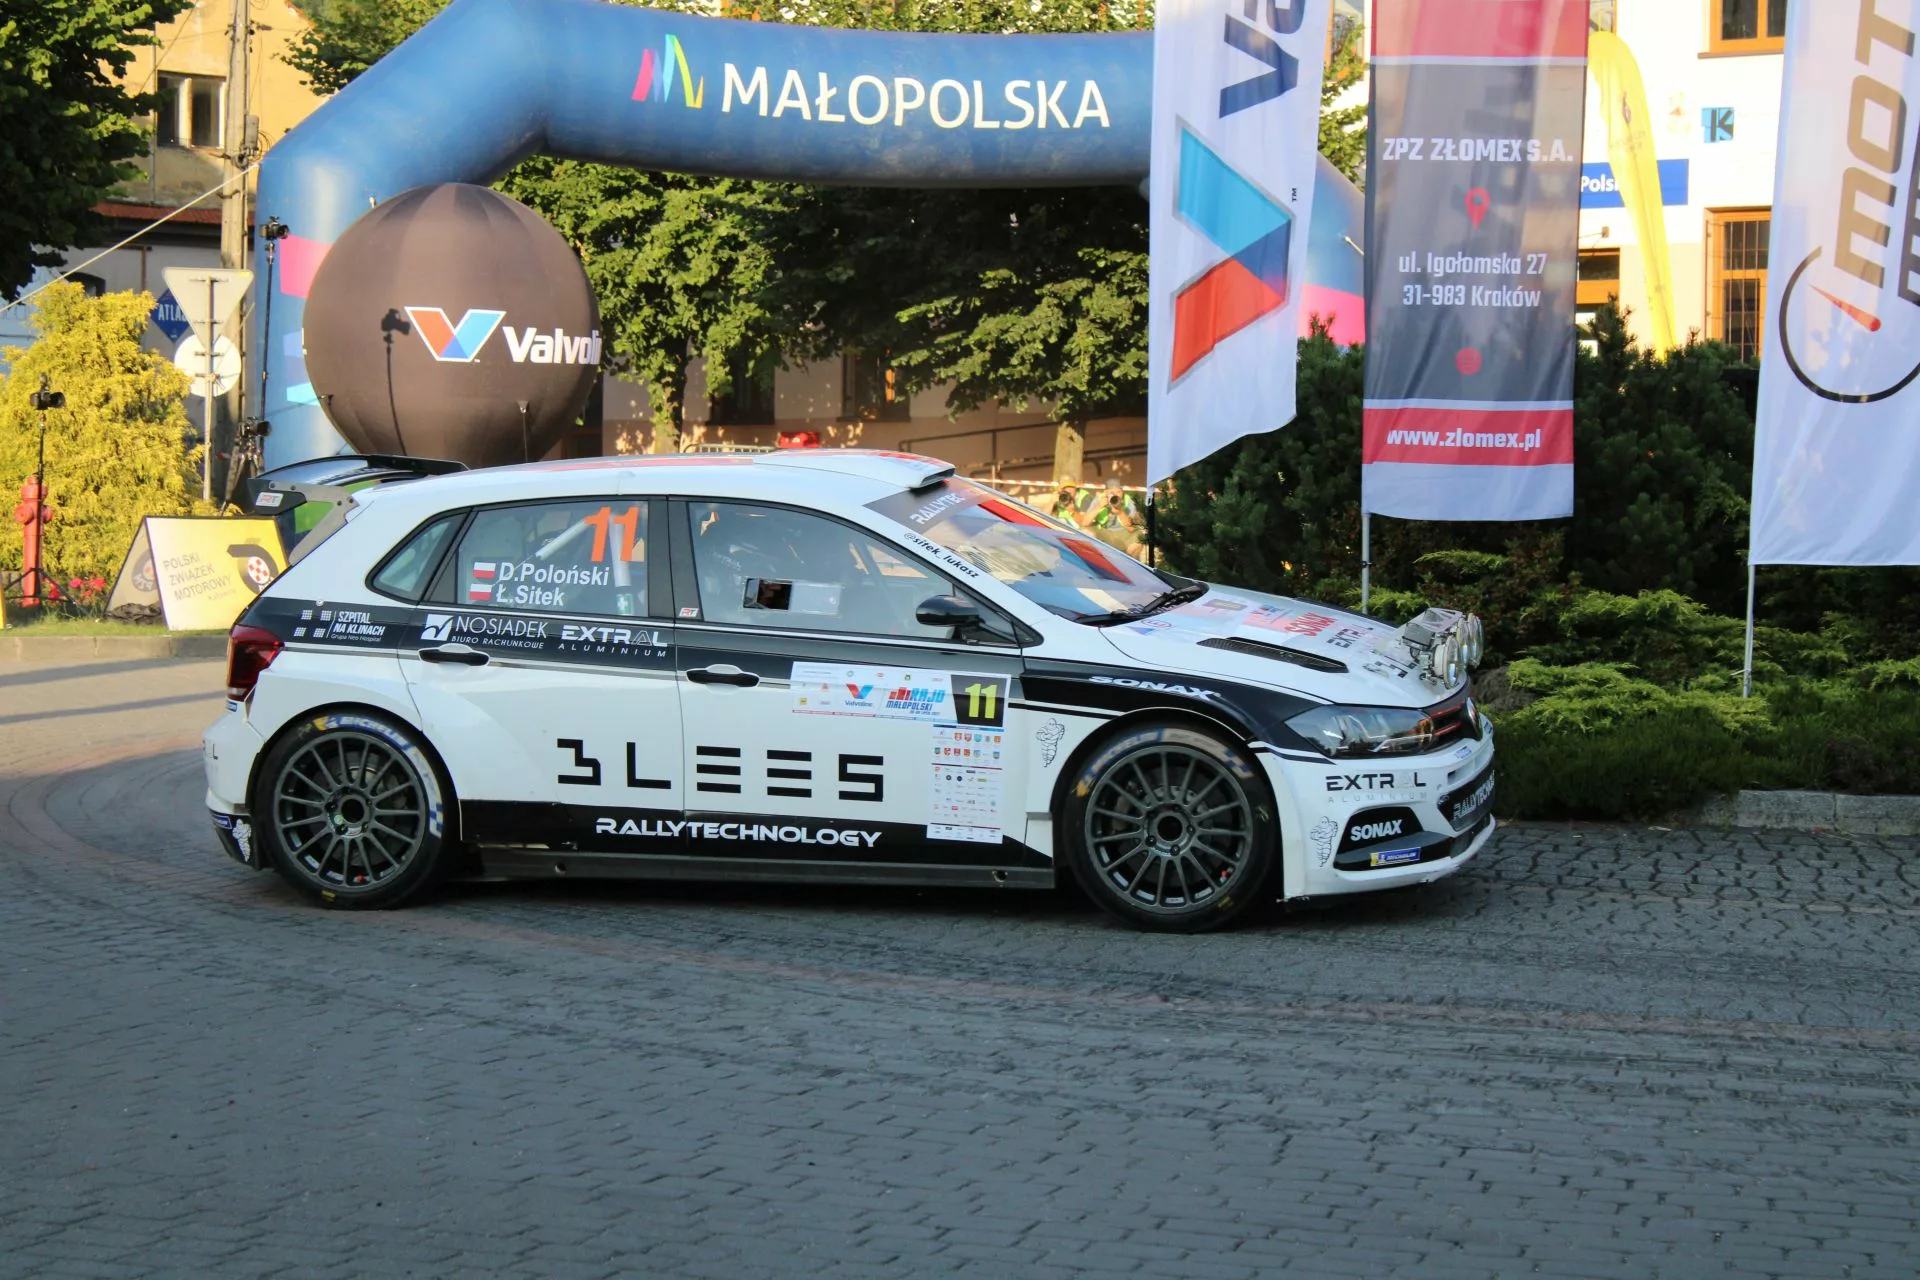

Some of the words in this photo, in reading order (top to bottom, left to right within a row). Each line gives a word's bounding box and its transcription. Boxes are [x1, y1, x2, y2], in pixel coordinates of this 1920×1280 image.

[721, 62, 1110, 129] MAŁOPOLSKA
[1383, 138, 1424, 161] ZPZ
[1430, 138, 1522, 162] ZŁOMEX
[1526, 138, 1574, 162] S.A.
[1398, 253, 1421, 274] ul.
[1427, 252, 1521, 275] Igołomska
[1526, 253, 1547, 274] 27
[1402, 285, 1466, 306] 31-983
[1471, 286, 1541, 307] Kraków
[1387, 428, 1541, 449] www.zlomex.pl
[584, 505, 640, 562] 11
[163, 552, 200, 570] POLSKI
[499, 562, 610, 586] D.Poloński
[496, 584, 564, 606] Ł.Sitek
[337, 611, 371, 624] SZPITAL
[455, 616, 548, 639] NOSIADEK
[333, 623, 346, 634] NA
[346, 625, 386, 637] KLINACH
[561, 625, 668, 648] EXTRAL
[451, 635, 479, 644] BIURO
[482, 638, 544, 649] RACHUNKOWE
[558, 643, 666, 657] ALUMINIUM
[1089, 675, 1216, 702] SONAX
[965, 683, 998, 719] 11
[596, 817, 882, 848] RALLYTECHNOLOGY
[1351, 819, 1403, 841] SONAX
